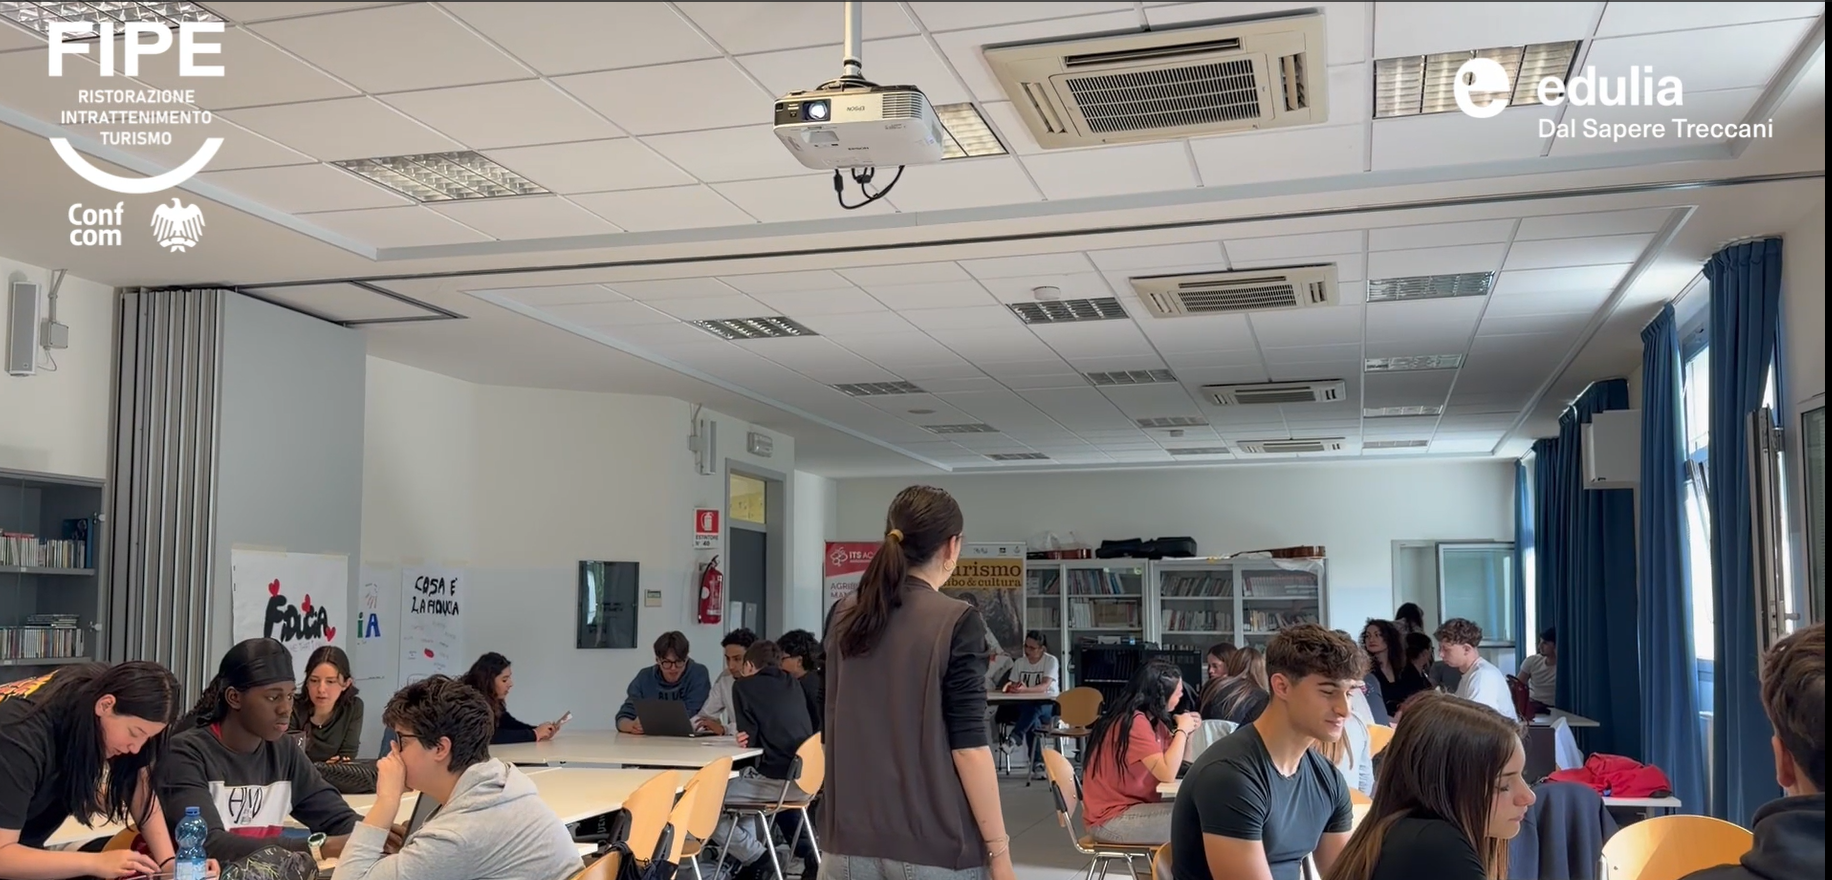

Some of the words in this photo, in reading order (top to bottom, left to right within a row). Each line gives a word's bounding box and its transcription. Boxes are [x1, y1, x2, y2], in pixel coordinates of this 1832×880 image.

[849, 551, 862, 559] ITS
[952, 561, 1021, 577] urismo
[414, 575, 445, 597] COSA
[978, 579, 1021, 587] cultura
